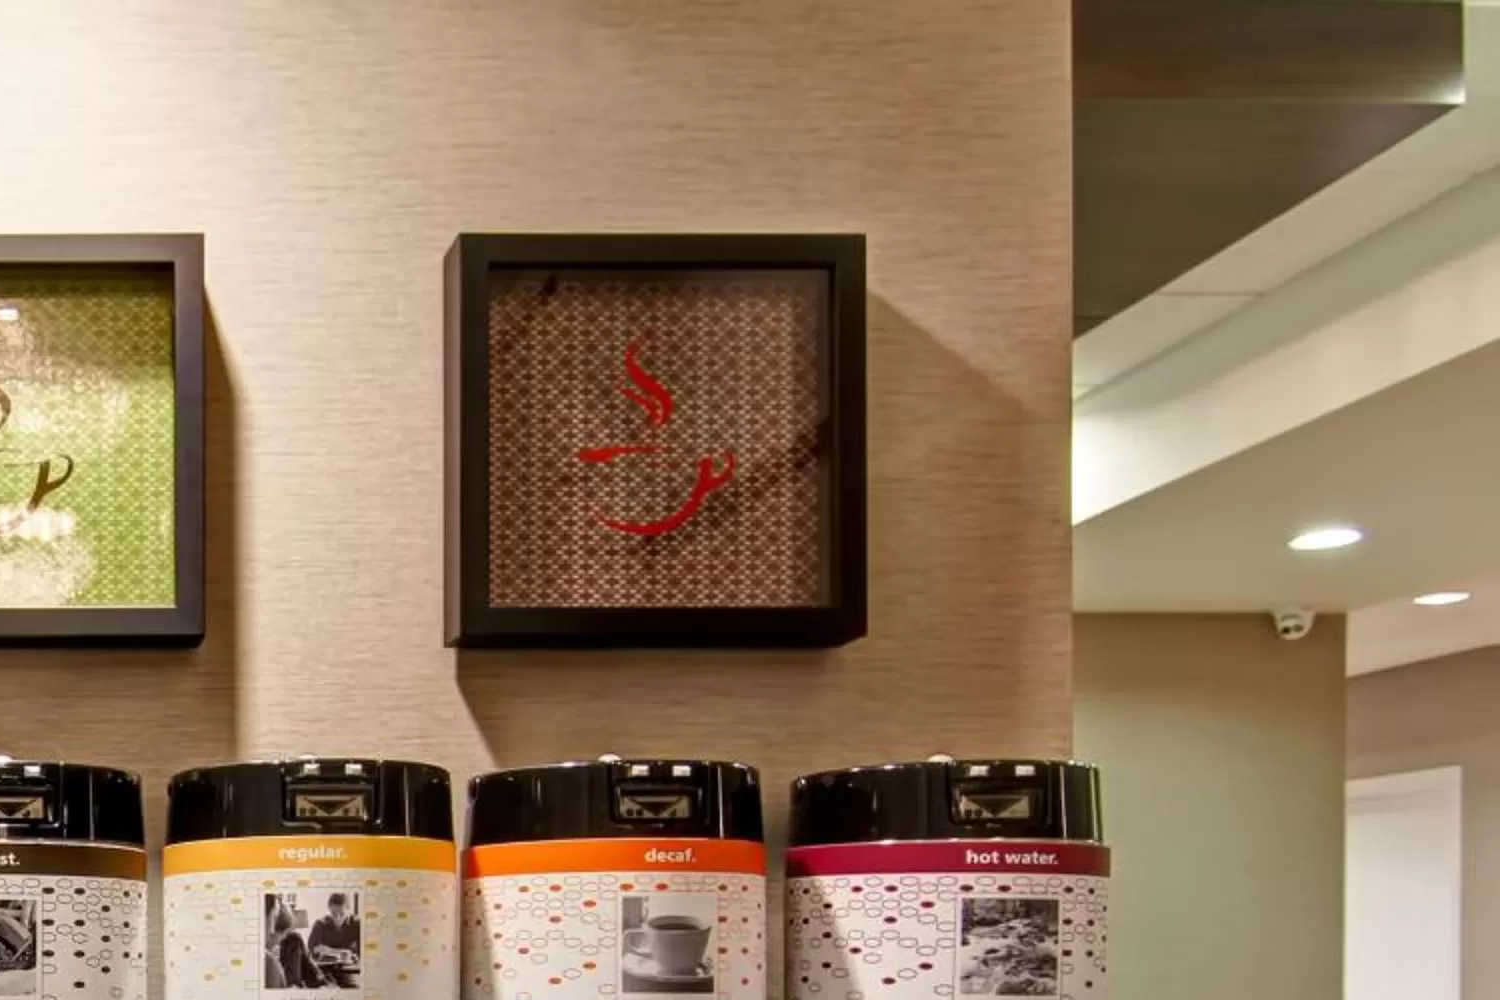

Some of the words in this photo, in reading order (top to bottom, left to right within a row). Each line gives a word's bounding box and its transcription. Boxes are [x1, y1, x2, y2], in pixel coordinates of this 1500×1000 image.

[278, 845, 348, 863] regular.
[644, 848, 697, 864] decaf.
[966, 849, 999, 864] hot
[1005, 851, 1059, 865] water.
